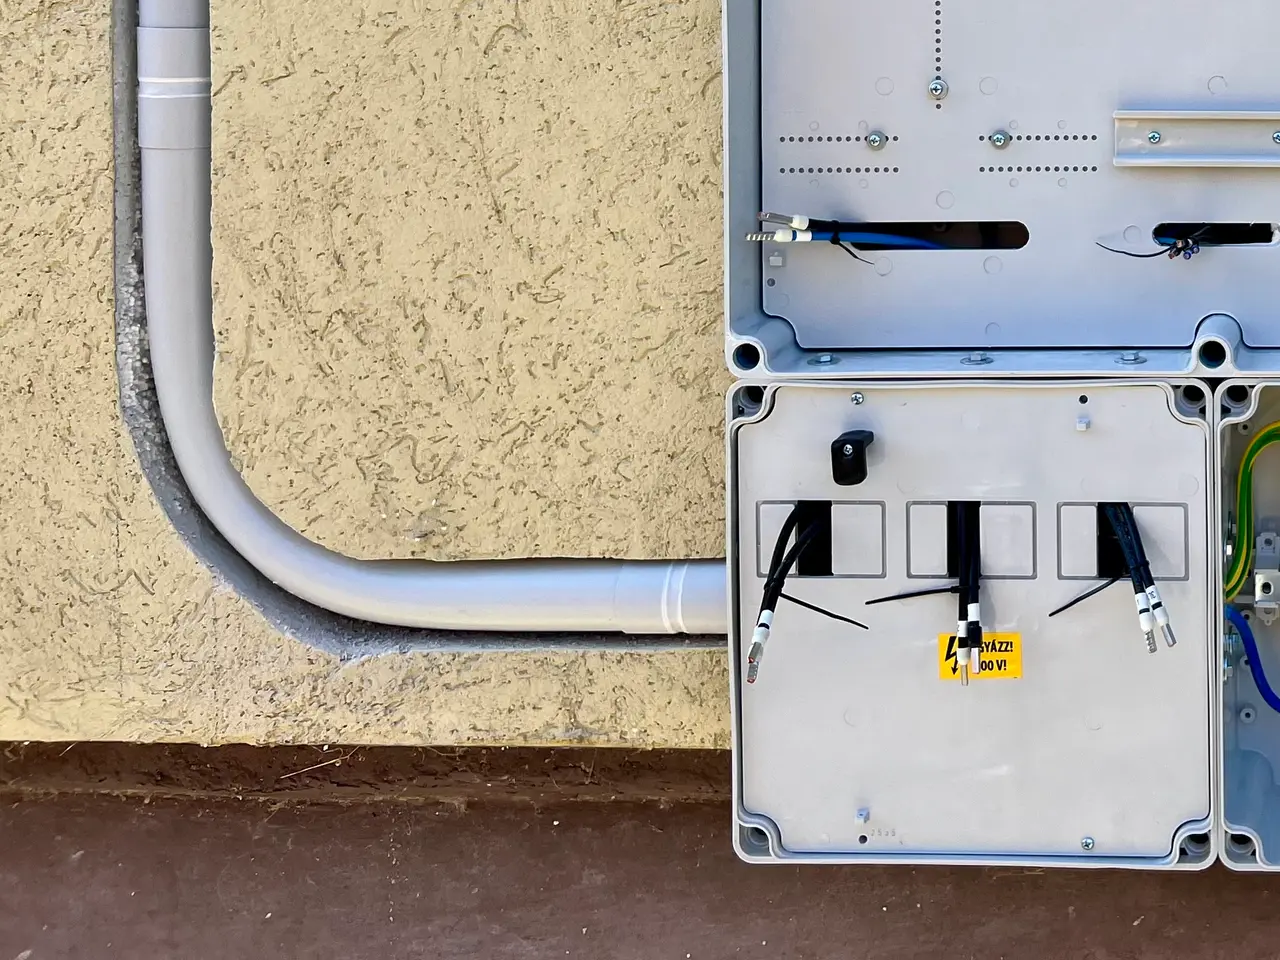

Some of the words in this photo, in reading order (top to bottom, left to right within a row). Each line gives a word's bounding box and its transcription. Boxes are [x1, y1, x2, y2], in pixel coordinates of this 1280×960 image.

[980, 639, 1013, 653] YÁZZ!
[981, 660, 994, 671] 00
[996, 659, 1007, 671] V!
